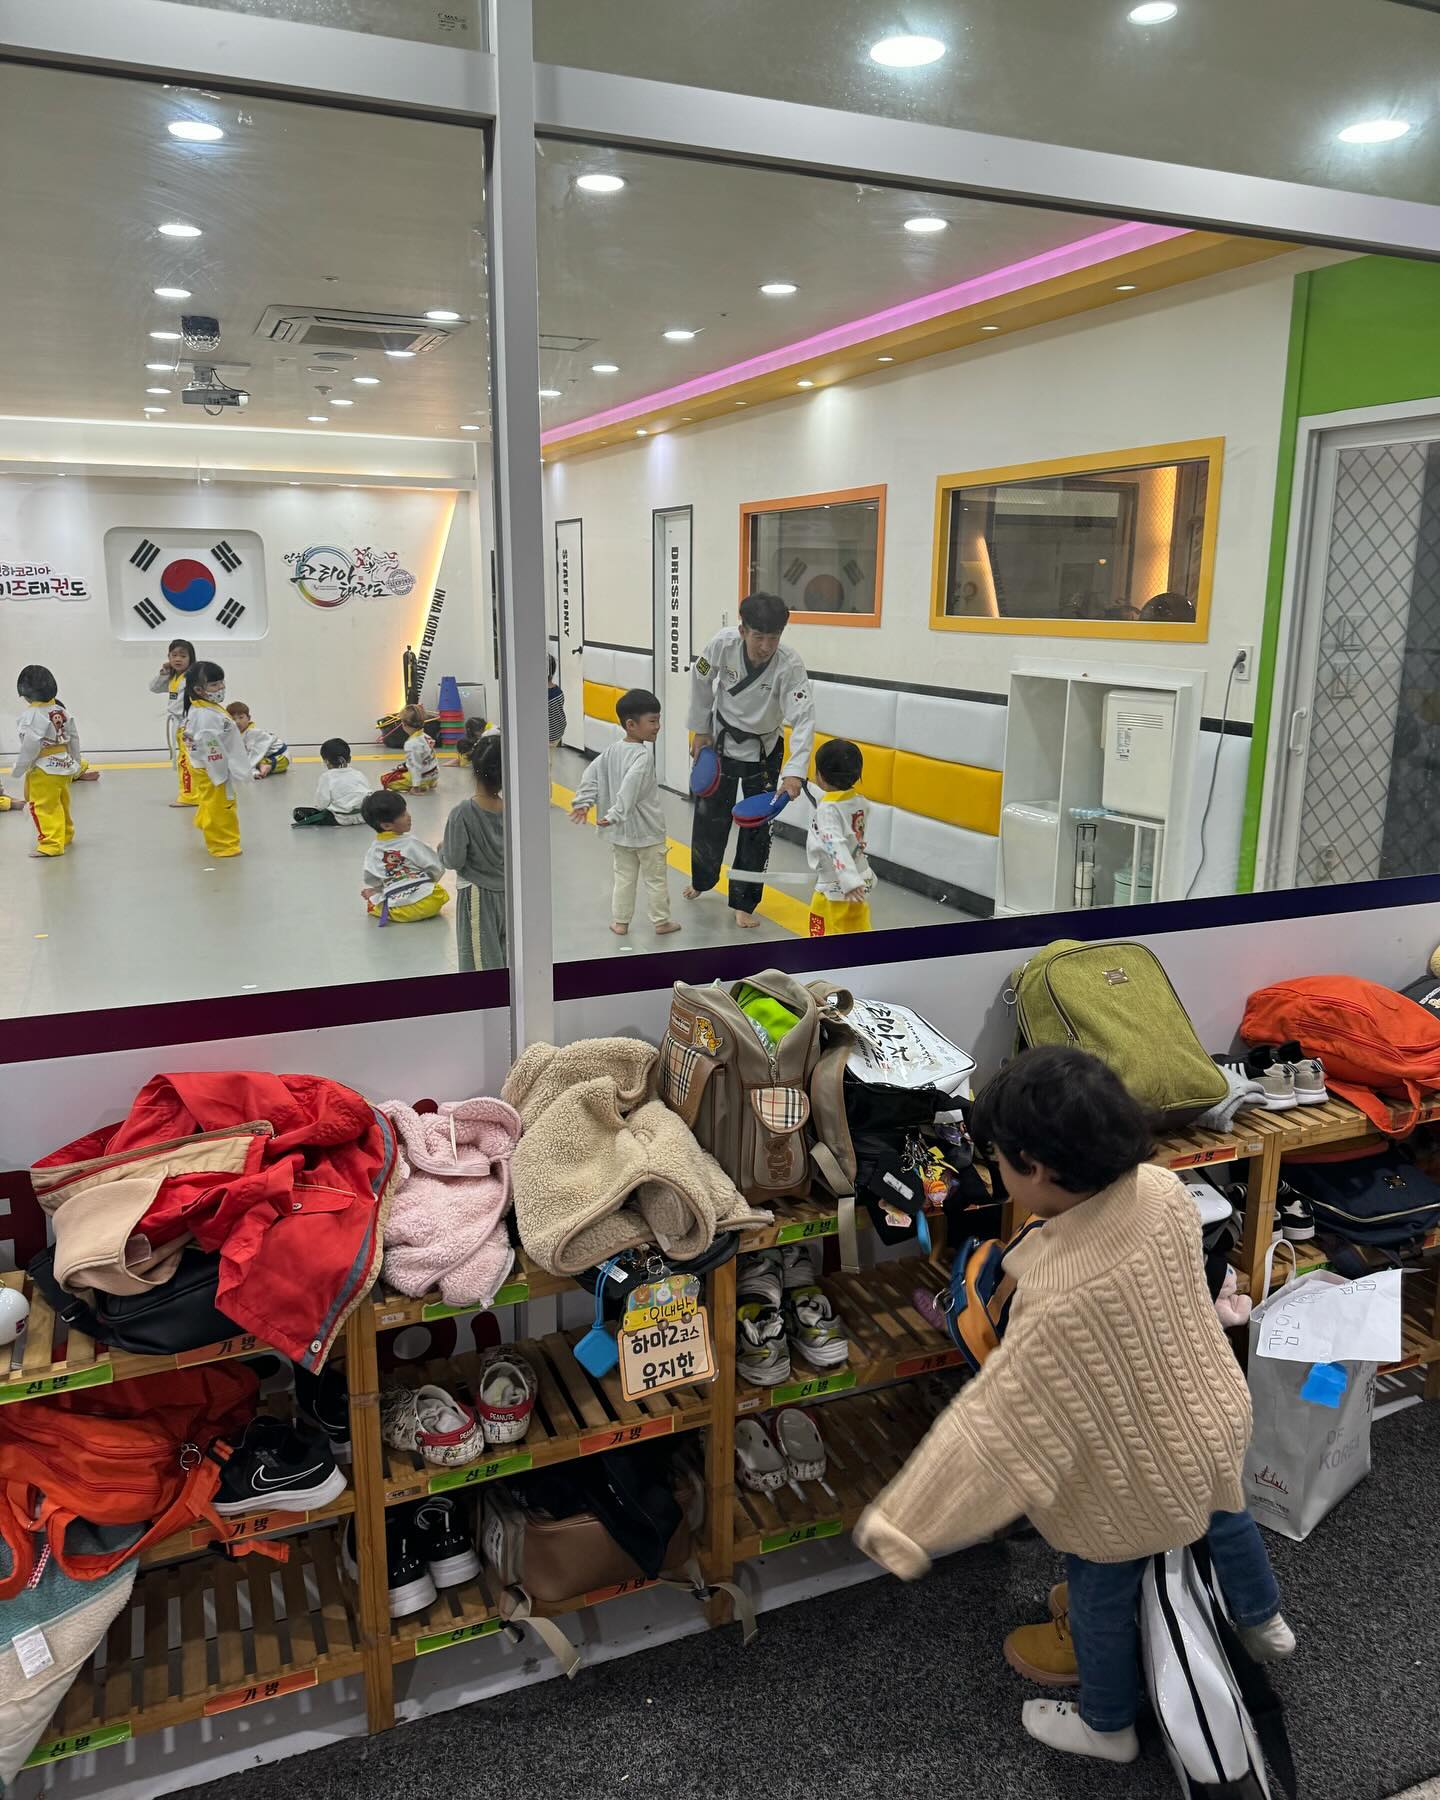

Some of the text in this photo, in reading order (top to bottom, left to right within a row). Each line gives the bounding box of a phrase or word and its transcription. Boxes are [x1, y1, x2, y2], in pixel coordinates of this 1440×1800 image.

[0, 564, 51, 577] 하코리아
[430, 588, 446, 613] INHA
[671, 547, 679, 673] DRESS ROOM
[422, 614, 439, 648] KOREA
[643, 1351, 695, 1389] 유지한
[790, 1526, 817, 1543] 신발
